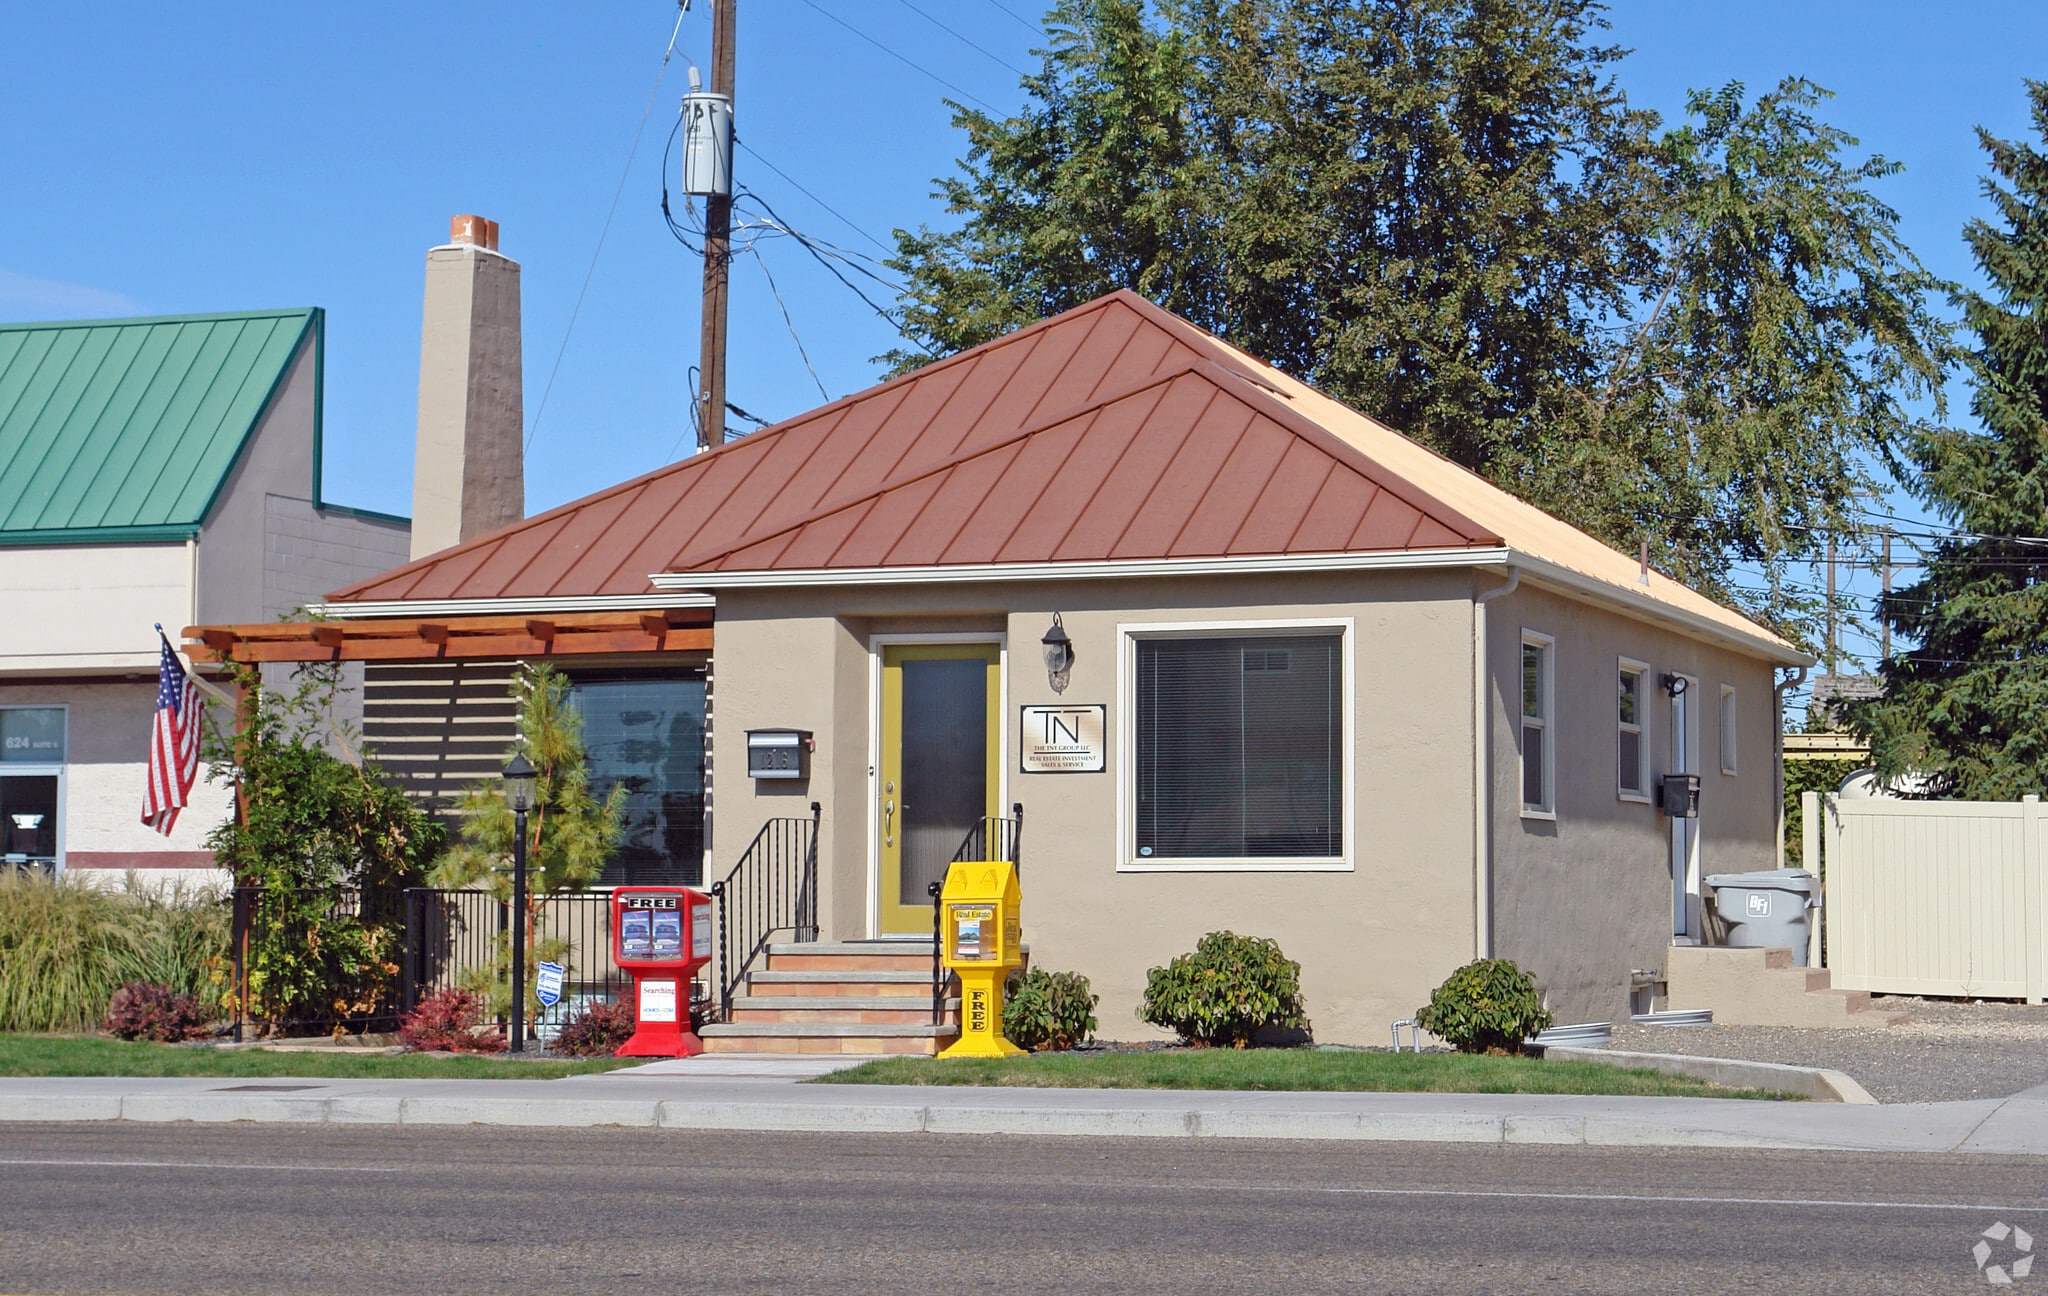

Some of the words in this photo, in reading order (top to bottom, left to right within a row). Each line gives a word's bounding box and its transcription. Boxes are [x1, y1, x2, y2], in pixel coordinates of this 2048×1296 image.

[6, 737, 30, 748] 624
[630, 899, 675, 908] FREE
[1749, 895, 1768, 914] BFI
[643, 986, 675, 995] Searching
[971, 992, 985, 1030] FREE
